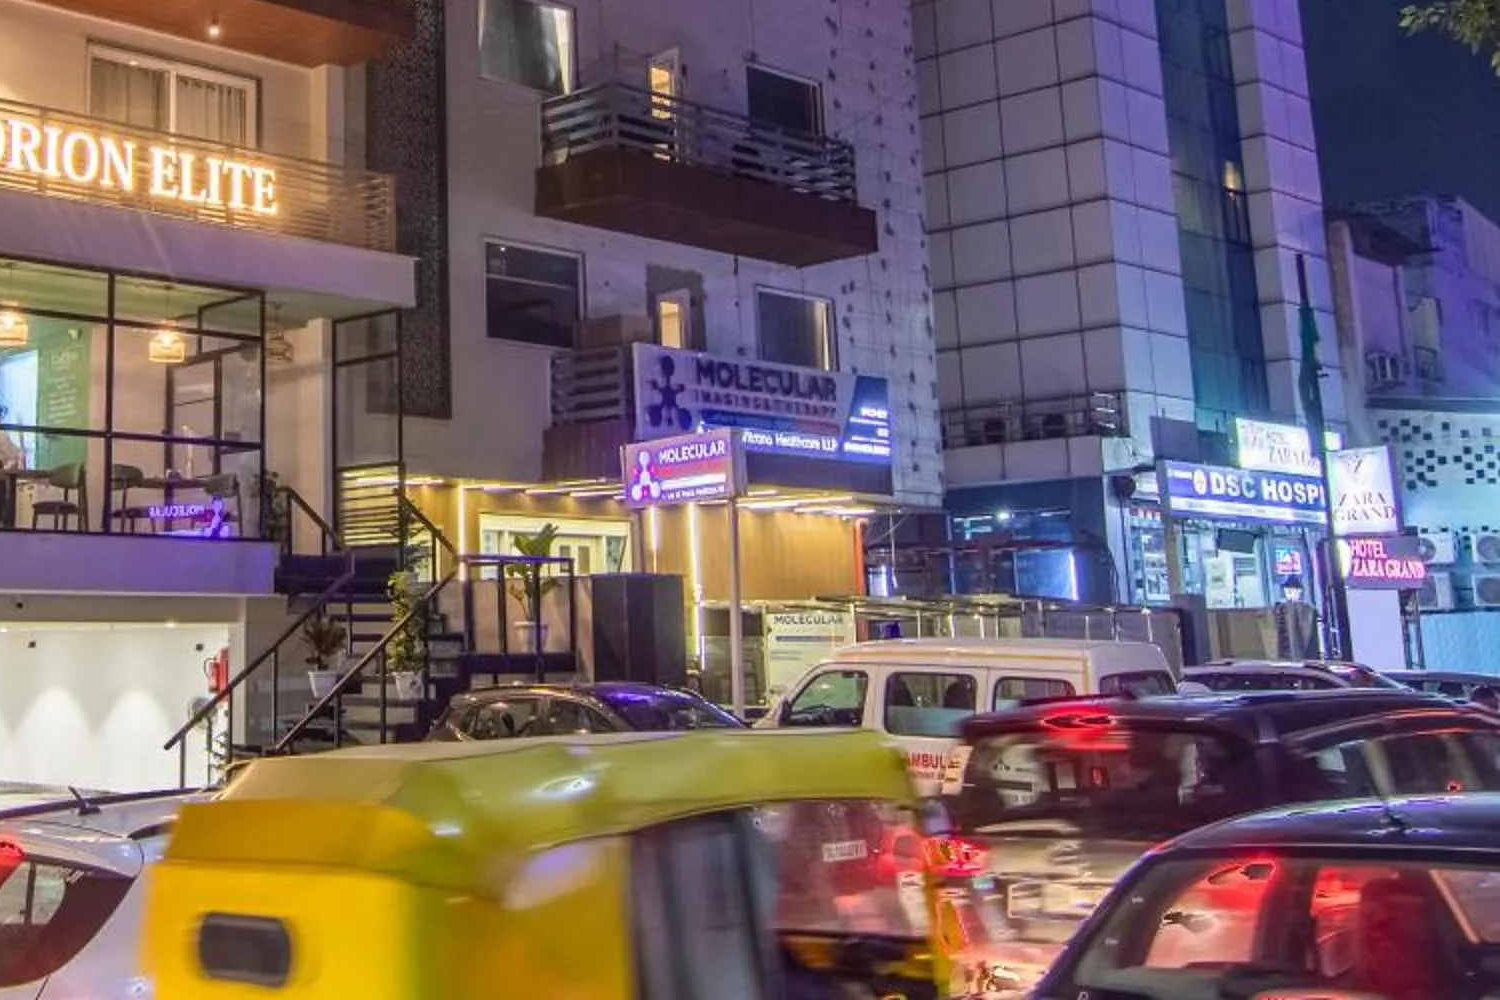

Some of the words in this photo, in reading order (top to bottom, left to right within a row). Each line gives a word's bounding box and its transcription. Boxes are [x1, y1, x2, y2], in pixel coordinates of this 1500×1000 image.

[148, 146, 278, 215] ELITE
[694, 357, 838, 401] MOLECULAR
[657, 440, 726, 465] MOLECULAR
[1210, 471, 1257, 498] DSC
[1338, 490, 1387, 507] ZARA
[1350, 539, 1388, 559] HOTEL
[1352, 559, 1385, 577] ZARA
[1385, 560, 1426, 579] GRAND
[773, 614, 846, 626] MOLECULAR
